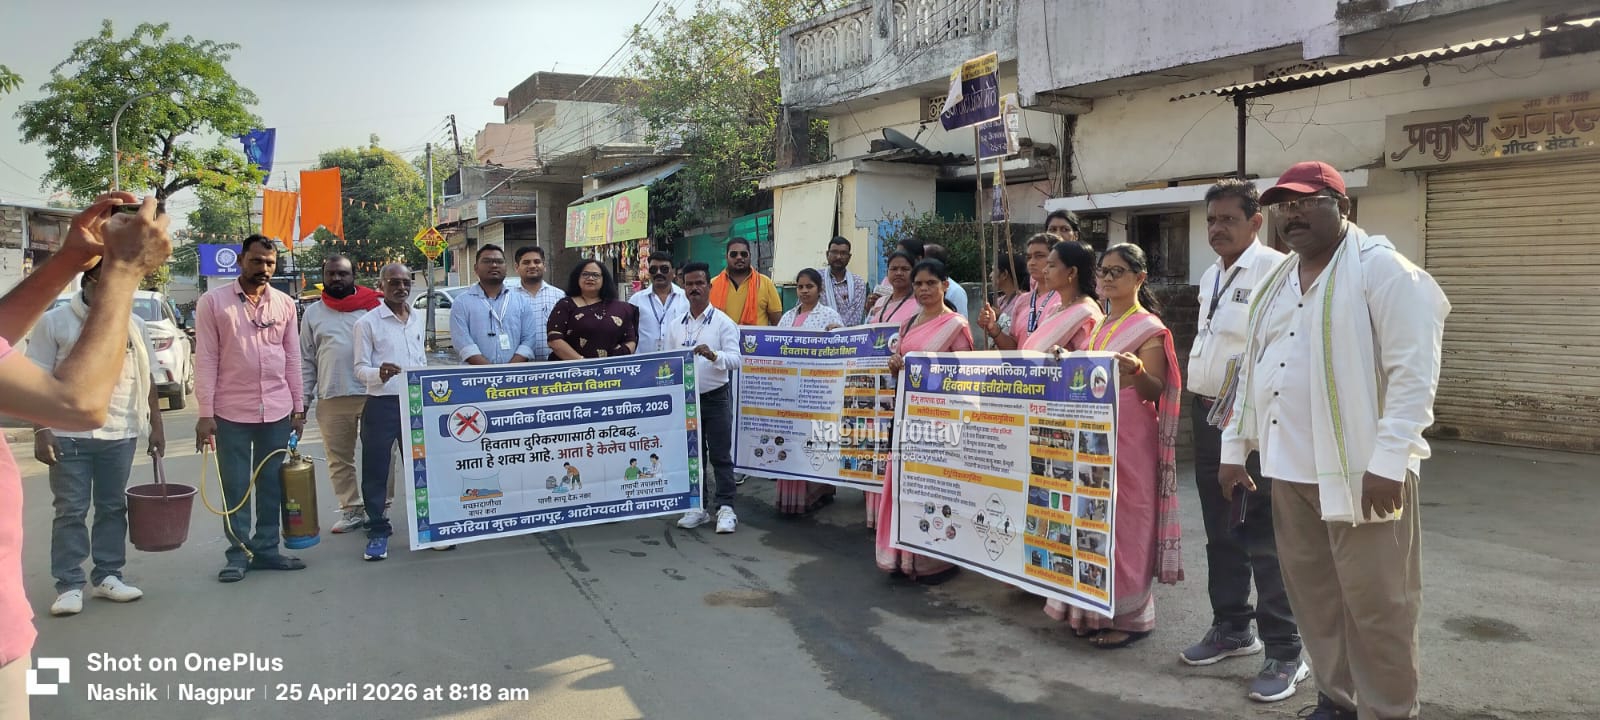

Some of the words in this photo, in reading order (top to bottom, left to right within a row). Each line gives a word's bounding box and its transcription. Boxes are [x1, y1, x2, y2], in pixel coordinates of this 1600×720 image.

[1391, 114, 1489, 161] प्रकाश
[764, 335, 793, 345] नागपूर
[850, 334, 868, 345] नागपूर
[780, 346, 809, 355] हिवताप
[461, 376, 503, 387] नागपूर
[506, 367, 600, 385] महानगरपालिका,
[604, 364, 640, 376] नागपूर
[930, 364, 956, 378] नागपूर
[958, 363, 1028, 378] महानगरपालिका,
[1030, 366, 1062, 382] नागपूर
[486, 386, 528, 400] हिवताप
[531, 387, 539, 396] व
[542, 381, 583, 394] हत्तीरोग
[585, 378, 621, 391] विभाग
[942, 378, 972, 391] हिवताप
[974, 382, 979, 391] व
[981, 380, 1011, 394] हत्तीरोग
[1013, 381, 1045, 395] विभाग
[491, 414, 534, 427] जागतिक
[536, 410, 571, 423] हिवताप
[573, 407, 591, 419] दिन
[601, 407, 613, 417] 25
[616, 402, 643, 415] एप्रिल,
[646, 401, 668, 411] 2026
[481, 438, 521, 452] हिवताप
[524, 430, 595, 448] दुरिकरणासाठी
[599, 425, 639, 440] कटिबद्ध.
[456, 459, 481, 470] आता
[486, 455, 494, 467] हे
[498, 455, 525, 466] शक्य
[529, 450, 554, 463] आहे.
[558, 447, 582, 460] आता
[586, 444, 594, 457] हे
[598, 441, 626, 455] केलेच
[629, 439, 663, 451] पाहिजे.
[439, 520, 489, 536] मलेरिया
[492, 517, 517, 532] मुक्त
[520, 512, 565, 527] नागपूर,
[568, 502, 633, 521] आरोग्यदायी
